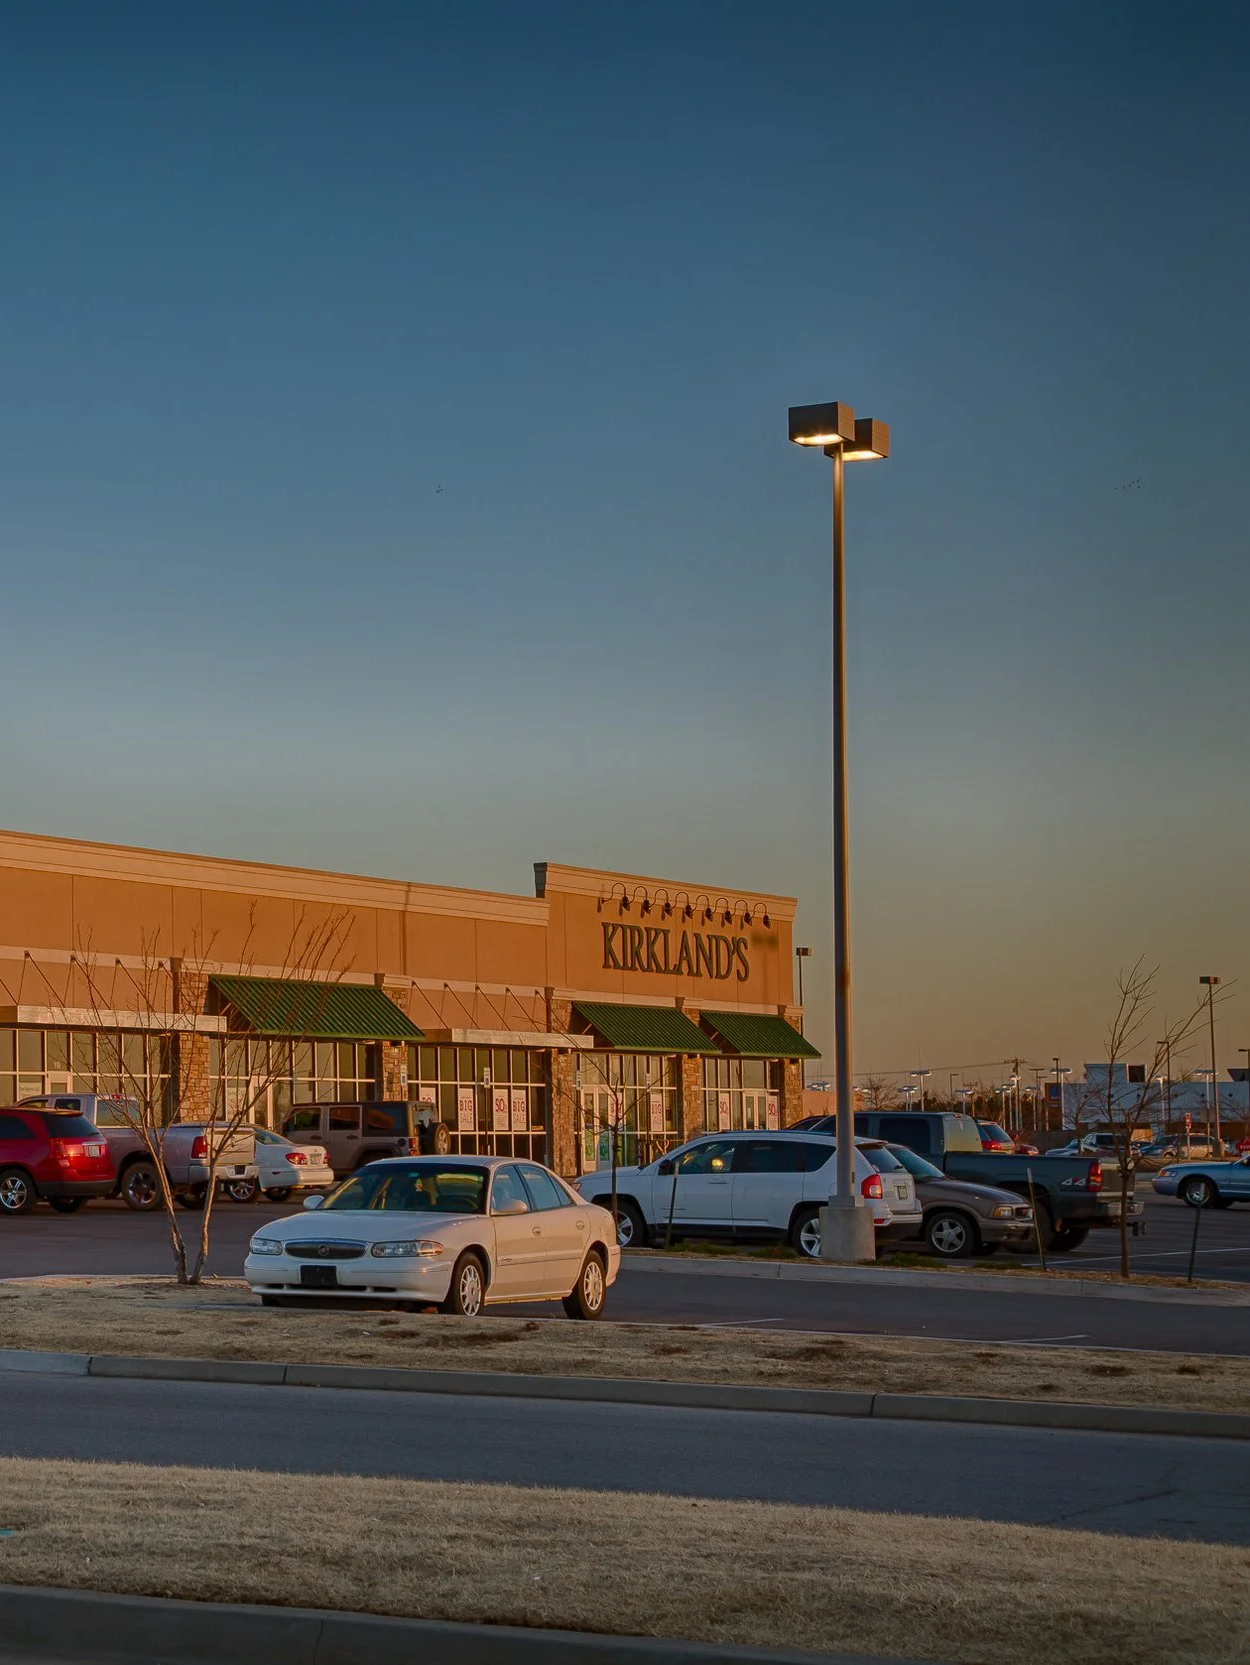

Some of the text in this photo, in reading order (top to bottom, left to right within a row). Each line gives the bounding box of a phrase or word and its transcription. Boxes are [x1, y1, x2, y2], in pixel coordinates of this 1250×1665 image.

[601, 922, 749, 982] KIRKLAND'S
[460, 1100, 472, 1111] BIG
[513, 1101, 525, 1111] BIG
[460, 1113, 472, 1123] SALE
[513, 1113, 525, 1122] SALE
